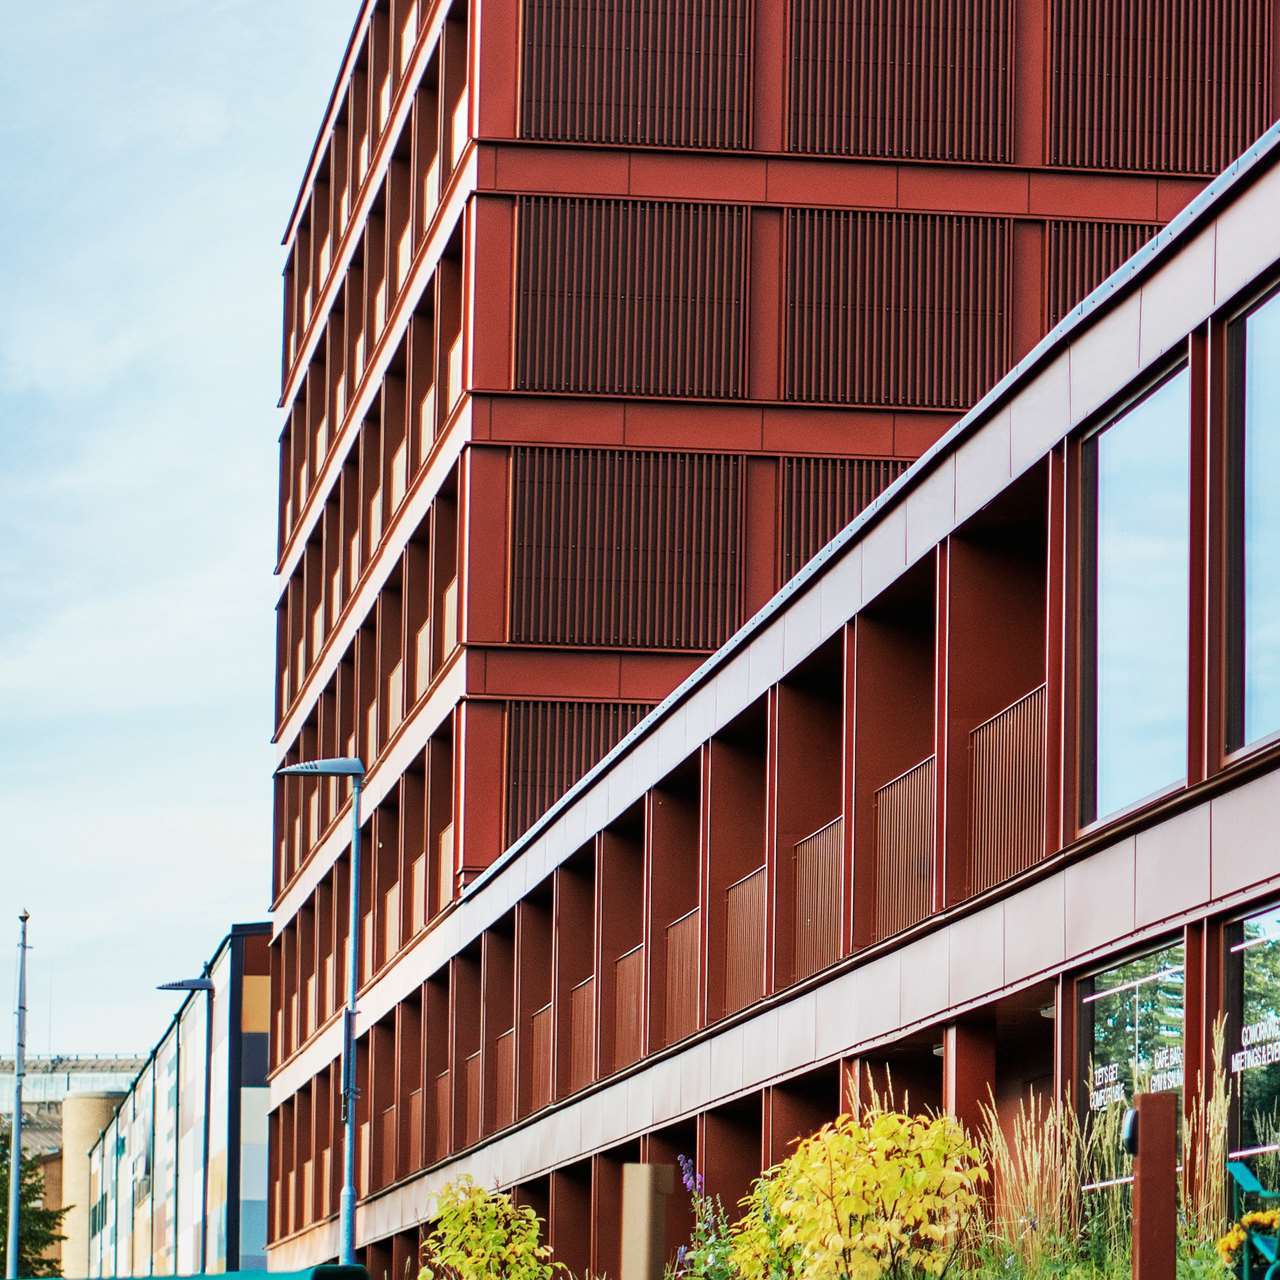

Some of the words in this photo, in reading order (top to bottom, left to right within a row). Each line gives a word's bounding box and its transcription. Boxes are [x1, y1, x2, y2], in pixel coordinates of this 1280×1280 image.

[1231, 1046, 1261, 1073] MEETINGS
[1261, 1045, 1267, 1066] &
[1094, 1065, 1108, 1087] LET'S
[1108, 1062, 1119, 1083] GET
